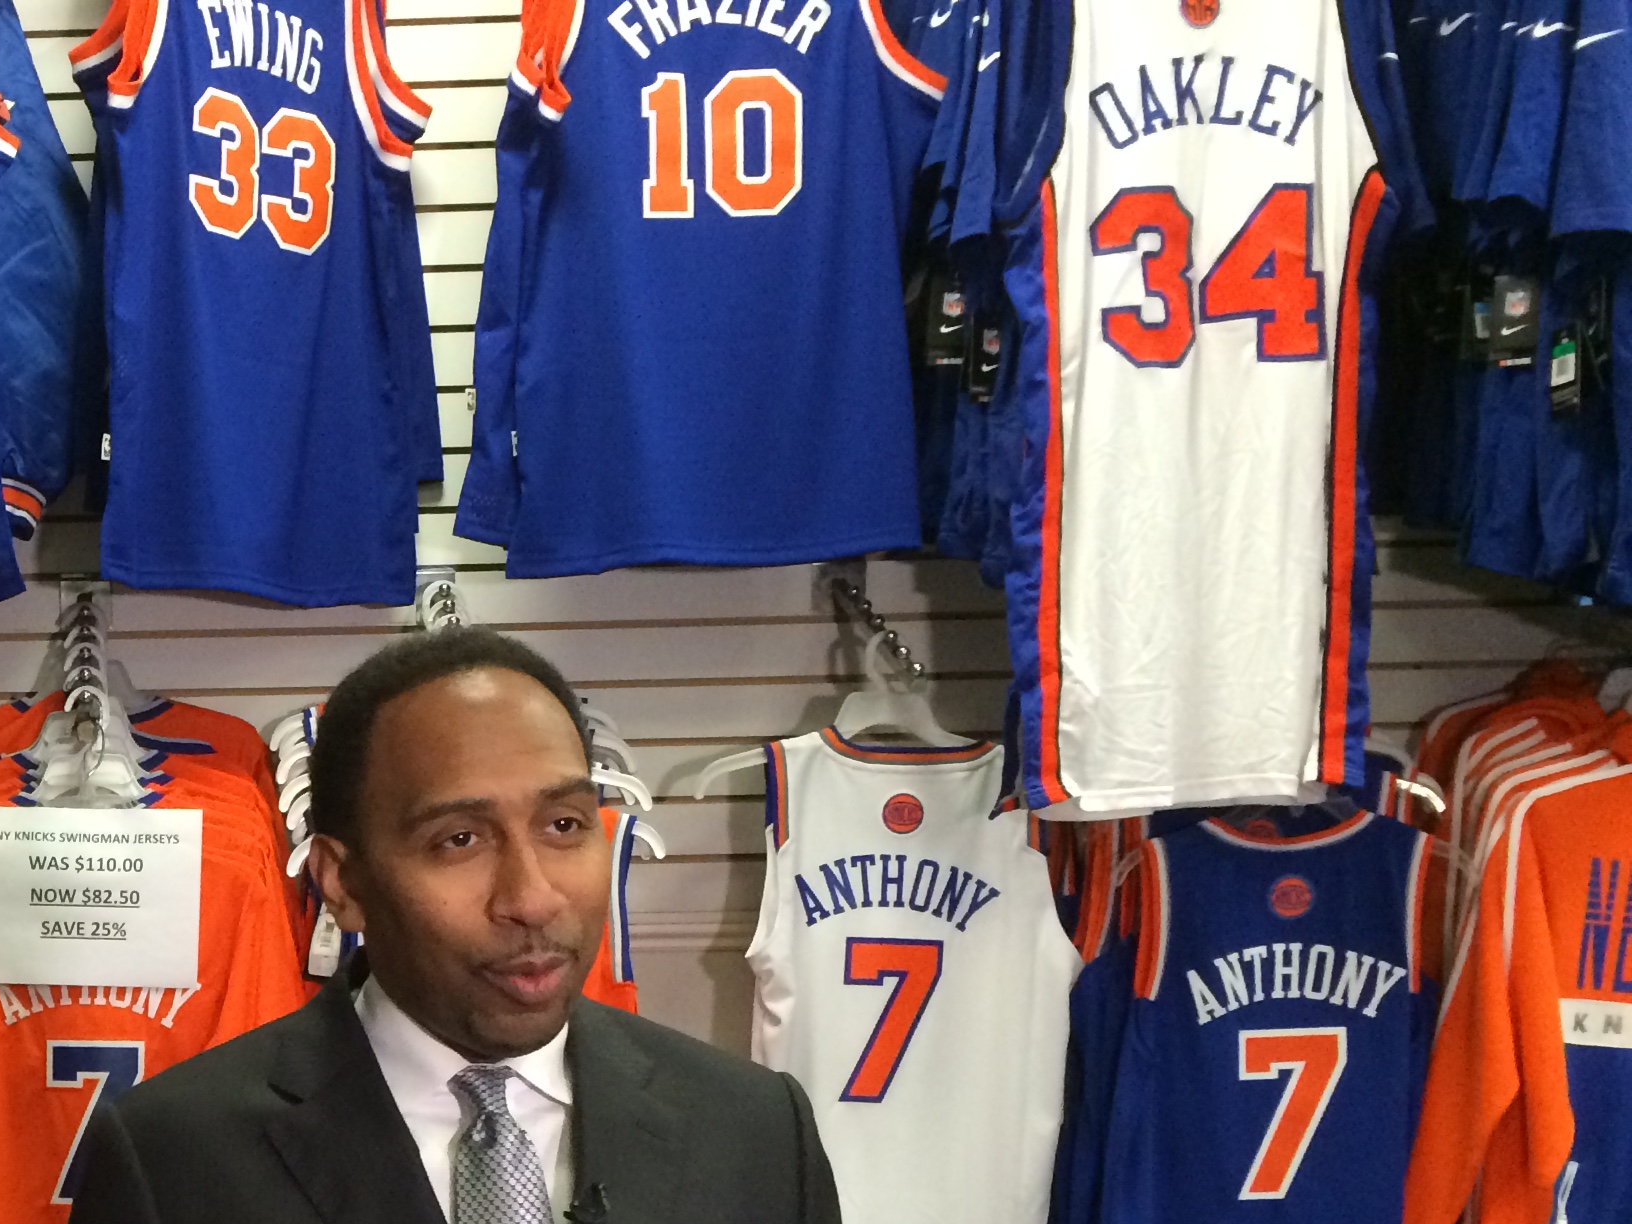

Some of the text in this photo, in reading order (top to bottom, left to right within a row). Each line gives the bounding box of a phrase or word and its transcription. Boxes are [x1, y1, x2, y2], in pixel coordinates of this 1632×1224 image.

[197, 0, 324, 94] EWING
[641, 68, 804, 219] 10
[1089, 55, 1324, 150] OAKLEY
[189, 86, 336, 255] 33
[1089, 183, 1327, 369] 34
[14, 831, 56, 843] KNICKS
[59, 832, 130, 844] SWINGMAN
[133, 834, 180, 845] JERSEYS
[29, 855, 144, 874] WAS $110.00
[30, 887, 140, 906] NOW $82.50
[40, 920, 127, 938] SAVE 25%
[794, 854, 1001, 933] ANTHONY
[837, 936, 944, 1104] 7
[1186, 942, 1409, 1026] ANTHONY
[46, 1040, 144, 1204] 7
[1238, 1026, 1348, 1201] 7
